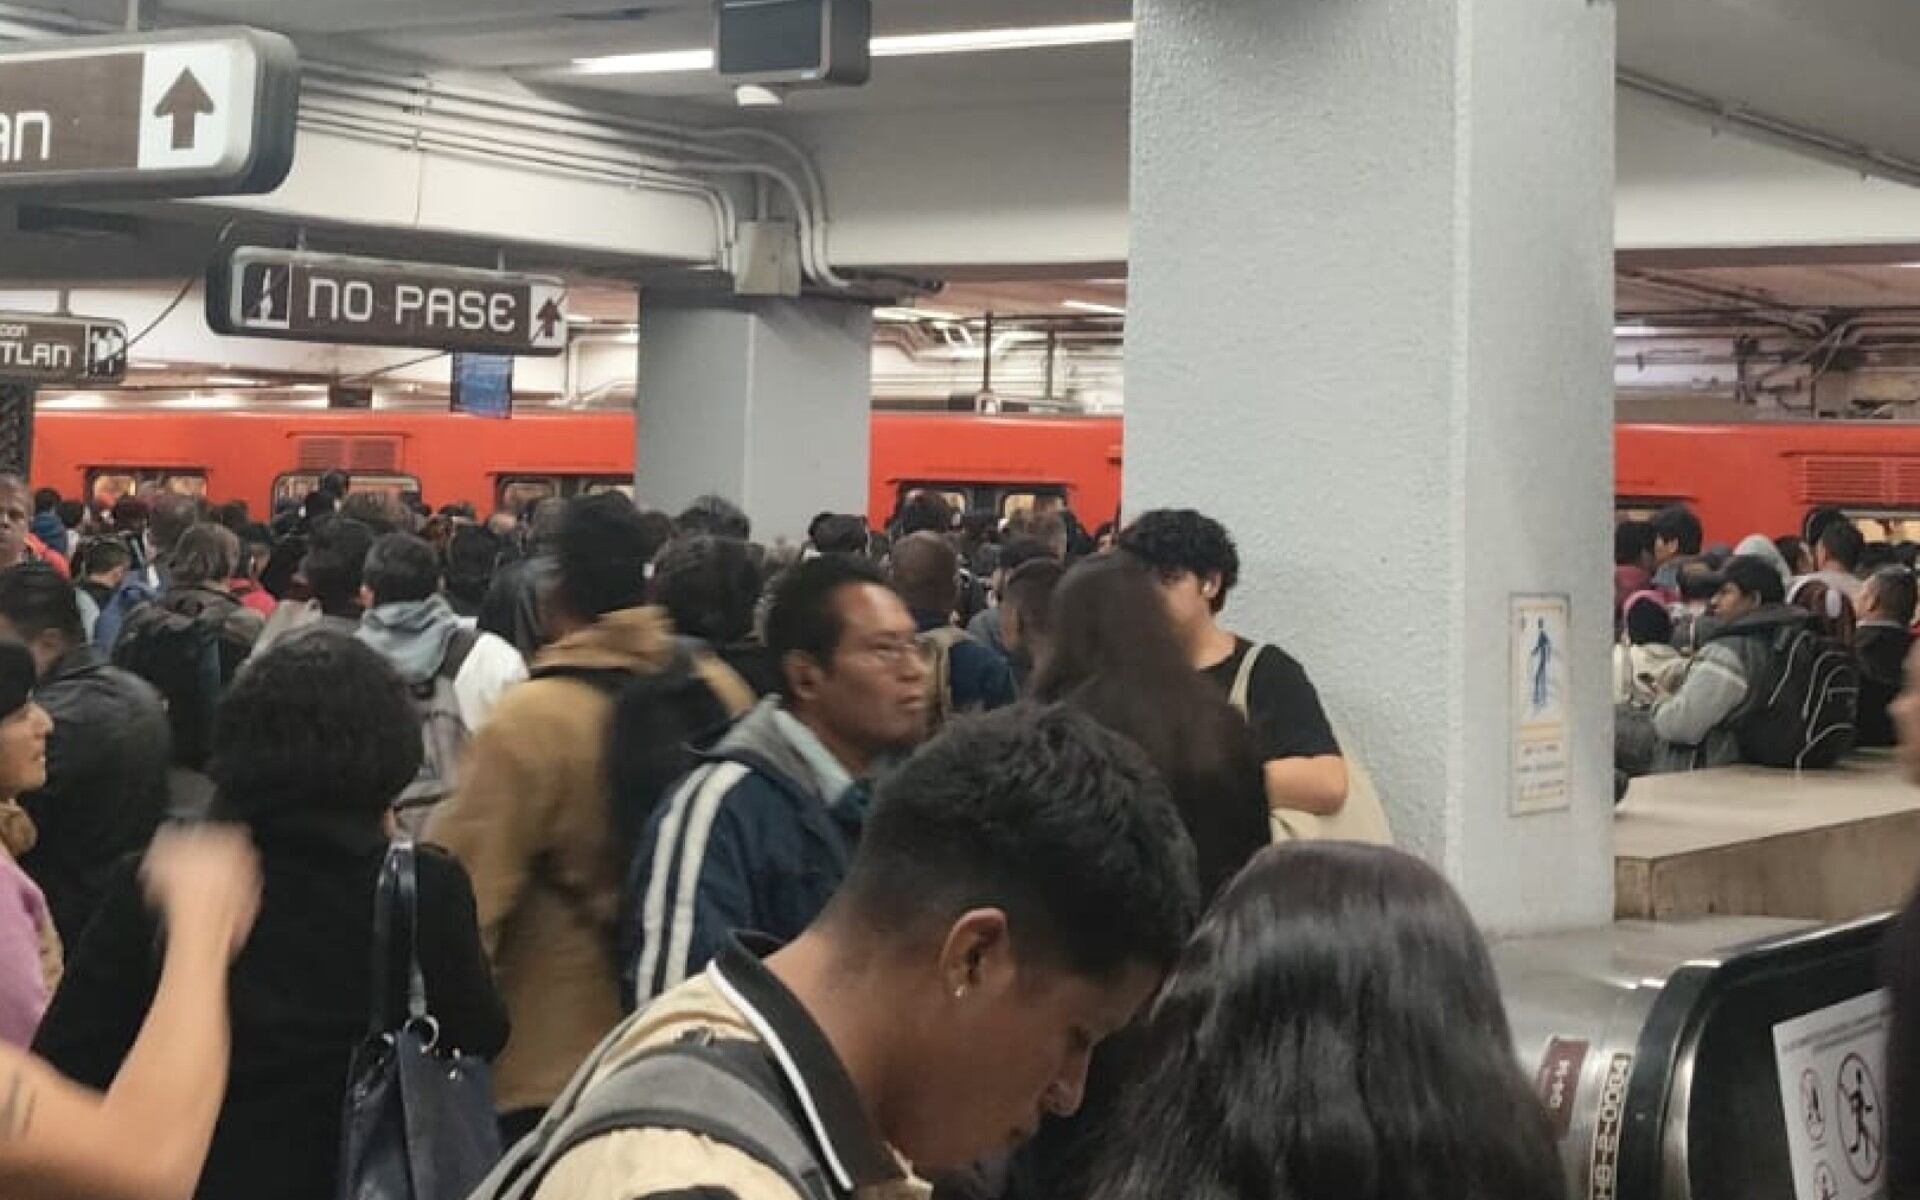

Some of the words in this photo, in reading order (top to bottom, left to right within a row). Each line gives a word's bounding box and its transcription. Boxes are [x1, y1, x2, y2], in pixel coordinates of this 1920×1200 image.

[307, 276, 373, 322] NO
[395, 285, 516, 332] PASE
[0, 341, 72, 368] TLAN
